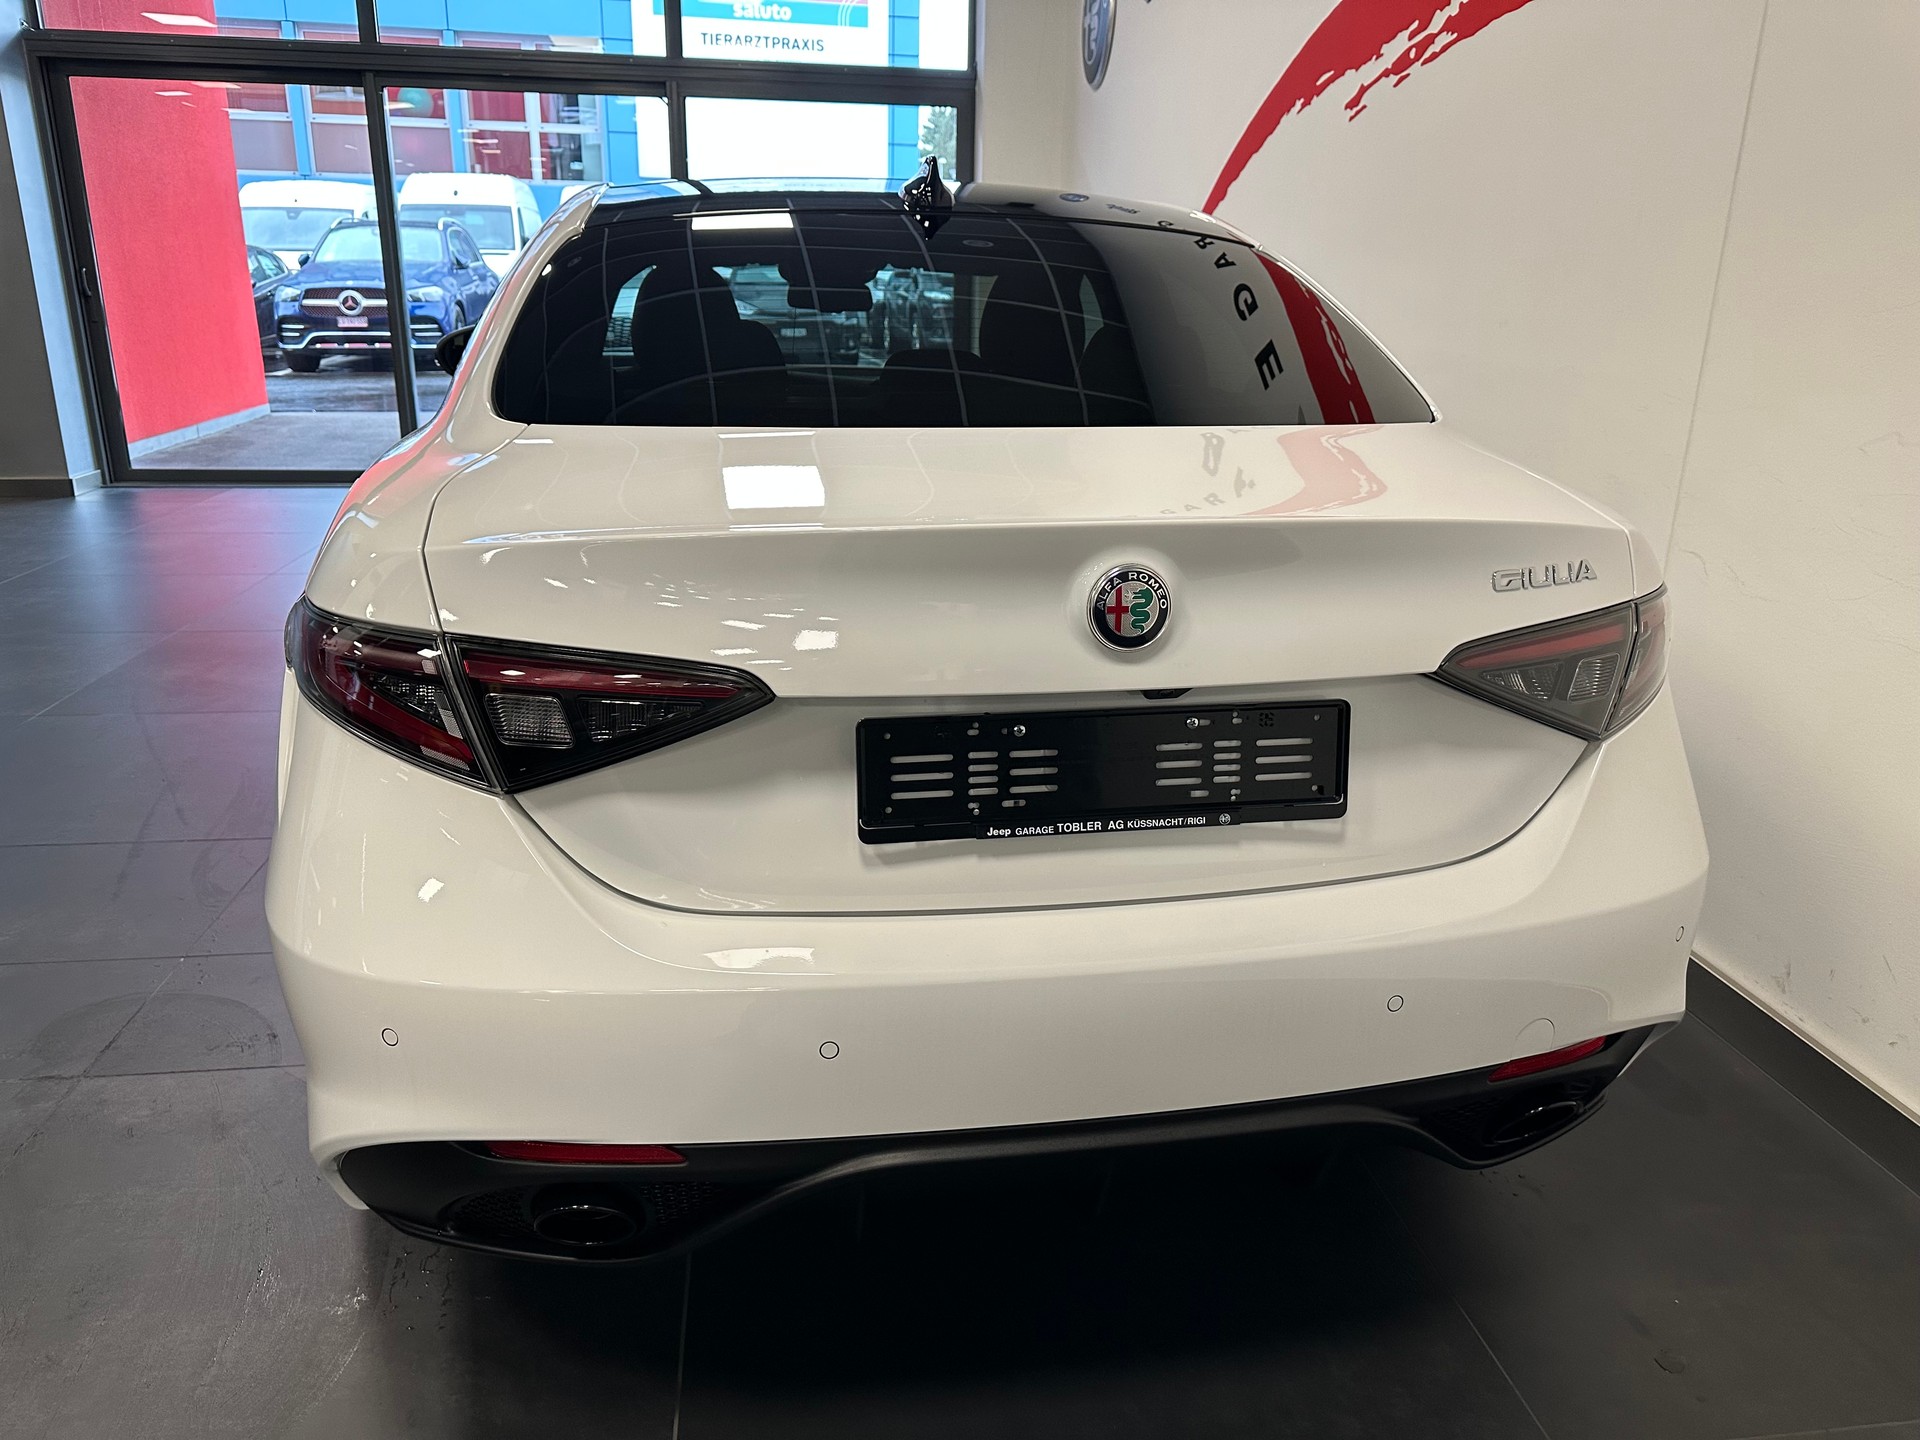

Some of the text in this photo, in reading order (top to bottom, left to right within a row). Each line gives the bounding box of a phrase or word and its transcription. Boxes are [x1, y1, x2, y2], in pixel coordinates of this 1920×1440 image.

[733, 1, 792, 21] saluto
[700, 32, 825, 52] TIERARZTPRAXIS
[1491, 558, 1598, 593] GIULIA
[1096, 571, 1168, 611] ALFA ROMEO
[987, 816, 1207, 838] Jeep GARAGE TOBLER AG KÜSSNACHT/RIGI
